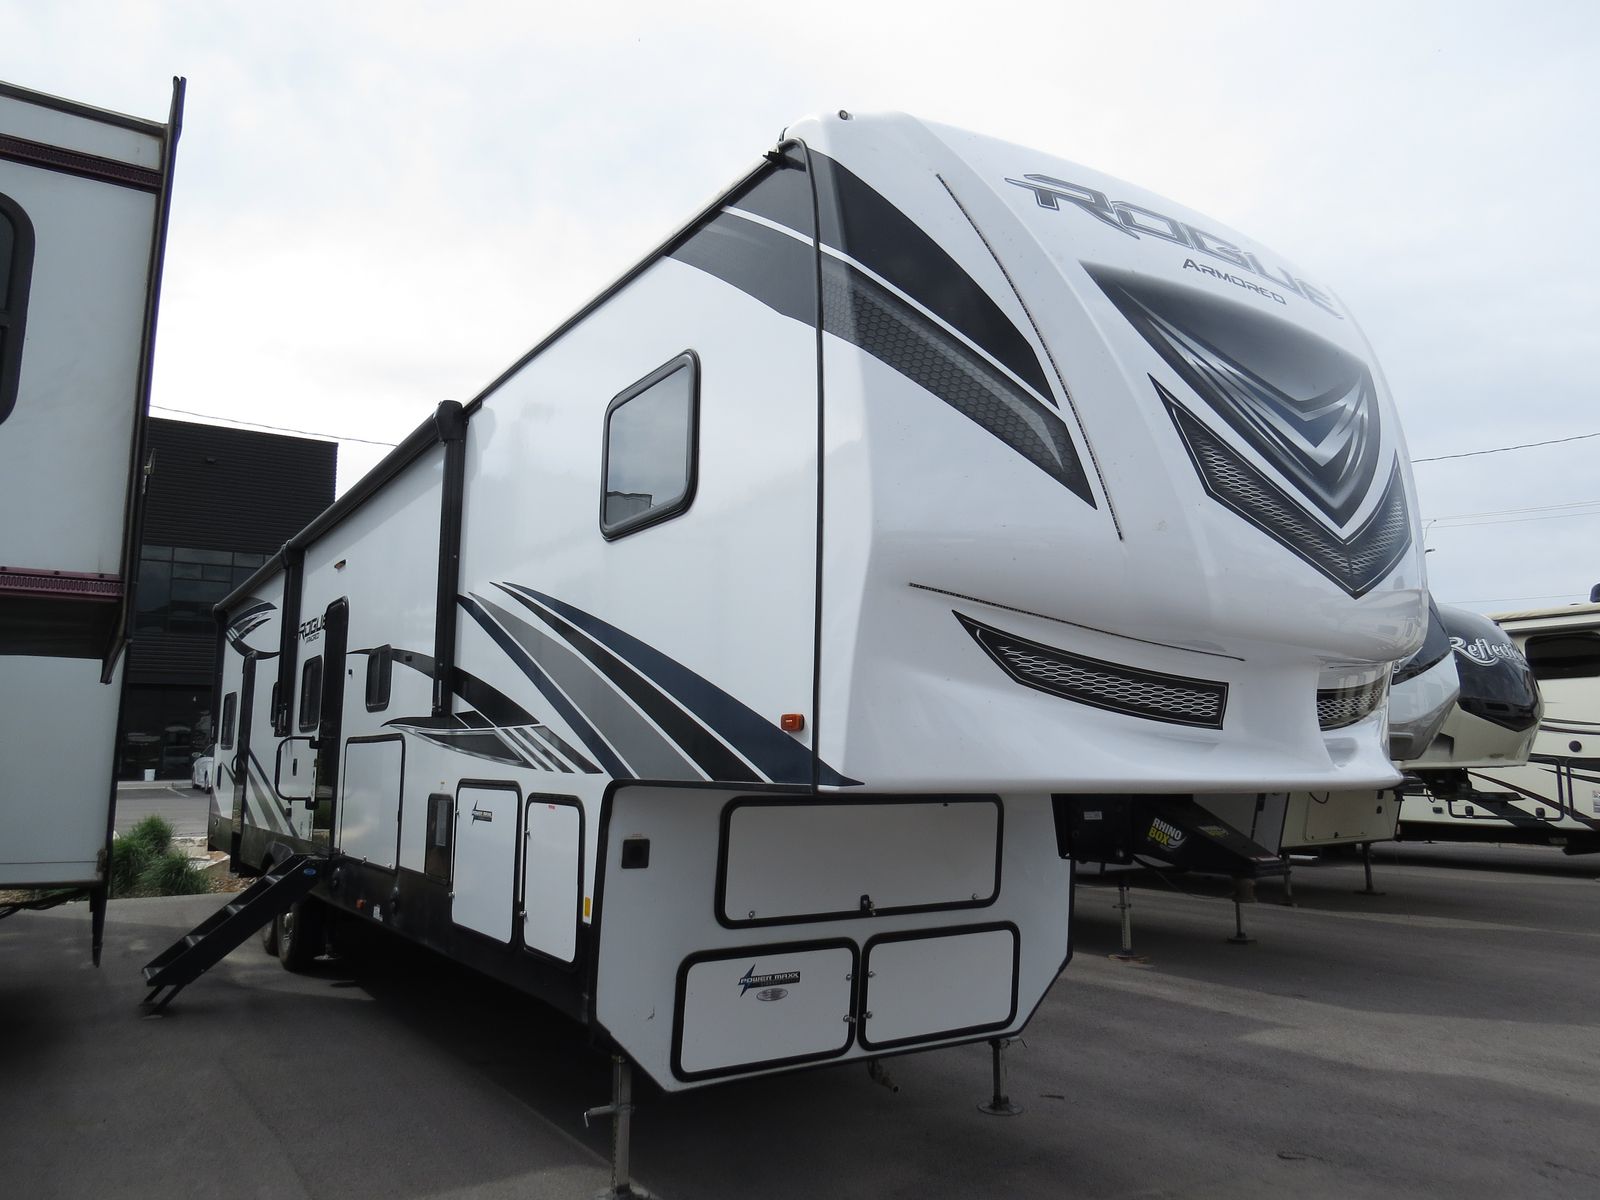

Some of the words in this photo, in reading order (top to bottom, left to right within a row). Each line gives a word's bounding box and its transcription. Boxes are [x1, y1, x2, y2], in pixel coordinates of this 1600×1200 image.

[1004, 173, 1344, 320] ROGUE
[1183, 258, 1287, 305] ARMORED
[1148, 826, 1170, 846] BOX
[1152, 817, 1182, 841] RHINO
[740, 975, 773, 984] POWER
